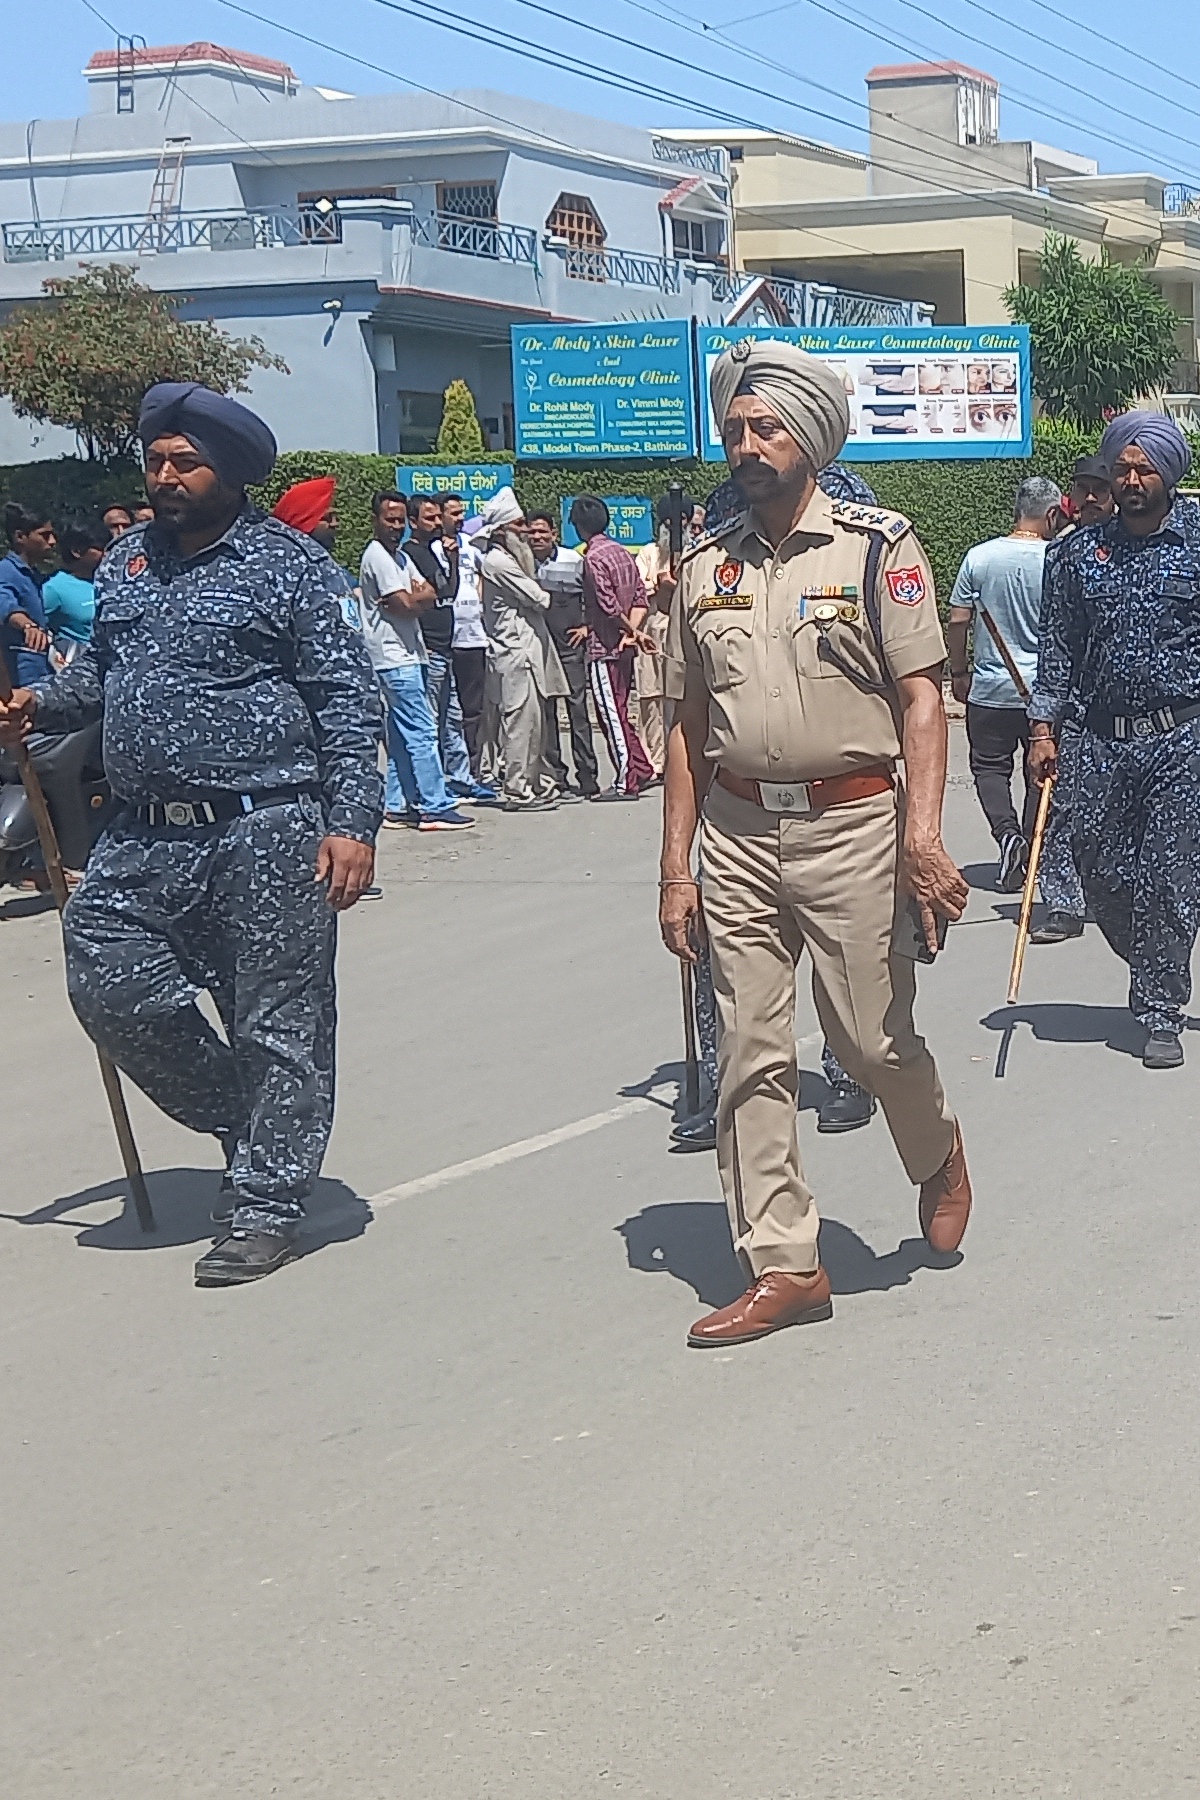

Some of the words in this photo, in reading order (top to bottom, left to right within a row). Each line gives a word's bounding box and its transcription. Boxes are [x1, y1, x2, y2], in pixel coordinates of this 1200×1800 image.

[519, 337, 547, 351] Dr.
[547, 335, 601, 352] Mody's
[603, 334, 635, 350] Skin
[638, 333, 680, 348] Laser
[706, 334, 732, 350] Dr
[798, 335, 829, 350] Skin
[833, 335, 876, 349] Laser
[881, 334, 972, 351] Cosmetology
[978, 333, 1021, 349] Clinic
[548, 371, 636, 388] Cosmetology
[639, 370, 681, 385] Clinic
[529, 402, 542, 412] Dr.
[543, 401, 569, 412] Rohit
[569, 401, 595, 414] Mody
[616, 399, 630, 408] Dr.
[630, 398, 659, 408] Vimmi
[659, 397, 685, 409] Mody
[521, 443, 541, 455] 438,
[542, 442, 572, 453] Model
[573, 442, 600, 453] Town
[601, 441, 642, 454] Phase-2,
[643, 441, 687, 452] Bathinda
[435, 471, 467, 492] ਚਮੜੀ
[469, 470, 498, 491] ਦੀਆਂ
[620, 506, 647, 519] ਰਸਤਾ
